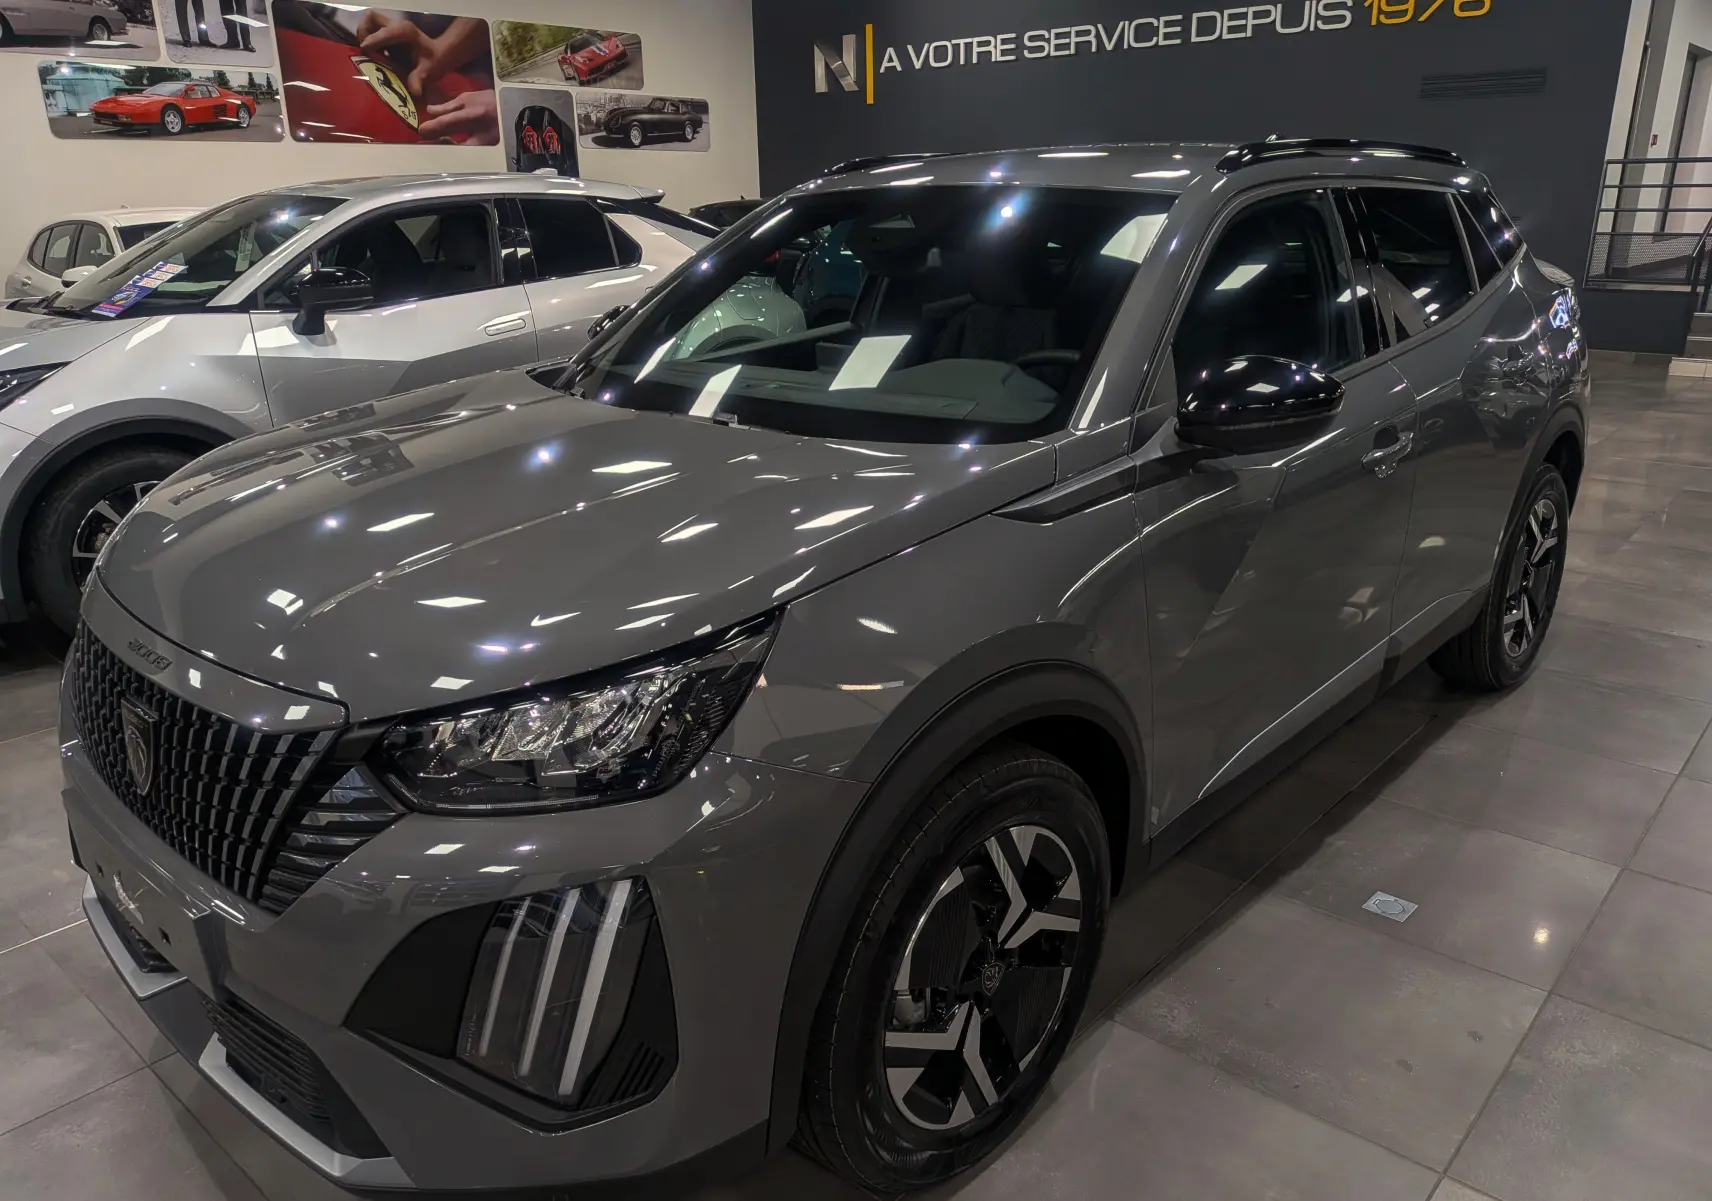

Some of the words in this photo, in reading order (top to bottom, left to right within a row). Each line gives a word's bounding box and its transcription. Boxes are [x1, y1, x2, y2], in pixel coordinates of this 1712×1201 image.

[813, 34, 859, 94] N
[880, 47, 902, 73] A
[907, 33, 1017, 70] VOTRE
[1023, 15, 1183, 59] SERVICE
[1190, 0, 1353, 43] DEPUIS
